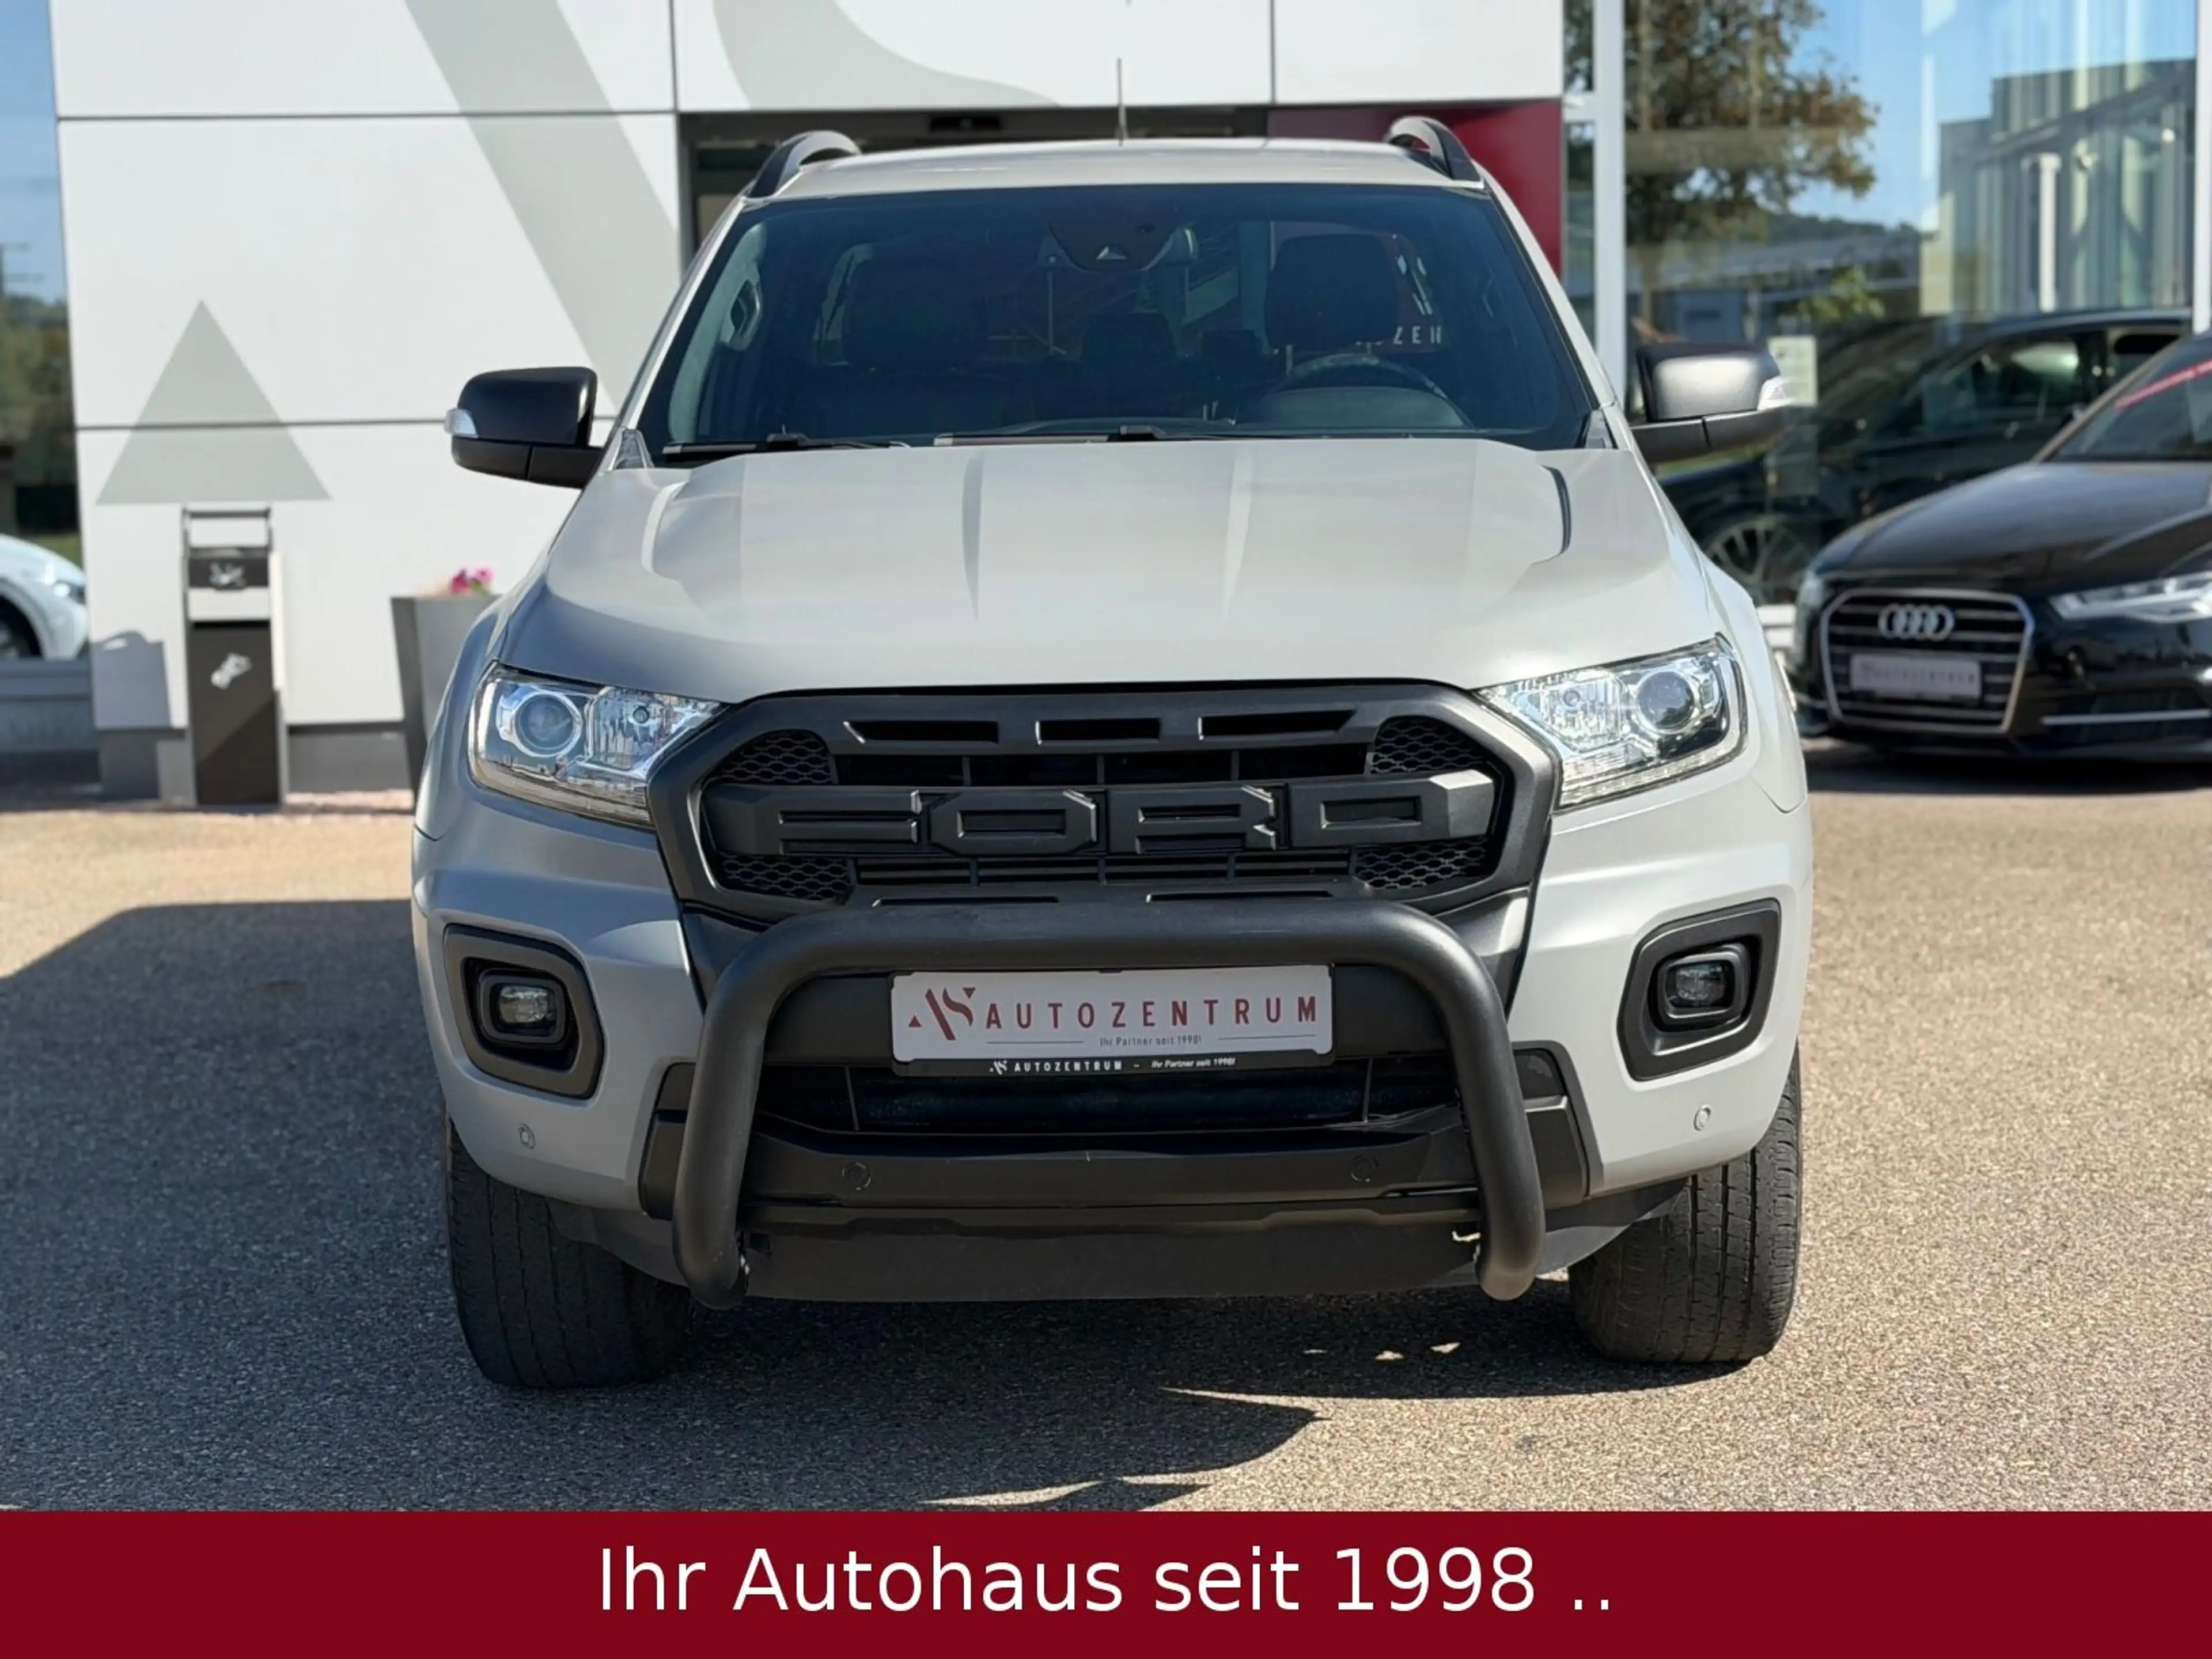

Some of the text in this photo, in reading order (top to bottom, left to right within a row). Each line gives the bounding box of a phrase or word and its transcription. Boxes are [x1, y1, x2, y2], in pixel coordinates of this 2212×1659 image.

[702, 769, 1494, 857] FORD
[986, 997, 1316, 1029] AUTOZENTRUM
[1100, 1037, 1112, 1046] Ihr
[1116, 1036, 1153, 1046] Partner
[1156, 1036, 1175, 1046] seit
[1014, 1060, 1122, 1072] AUTOZENTRUM
[1164, 1059, 1194, 1068] Partner
